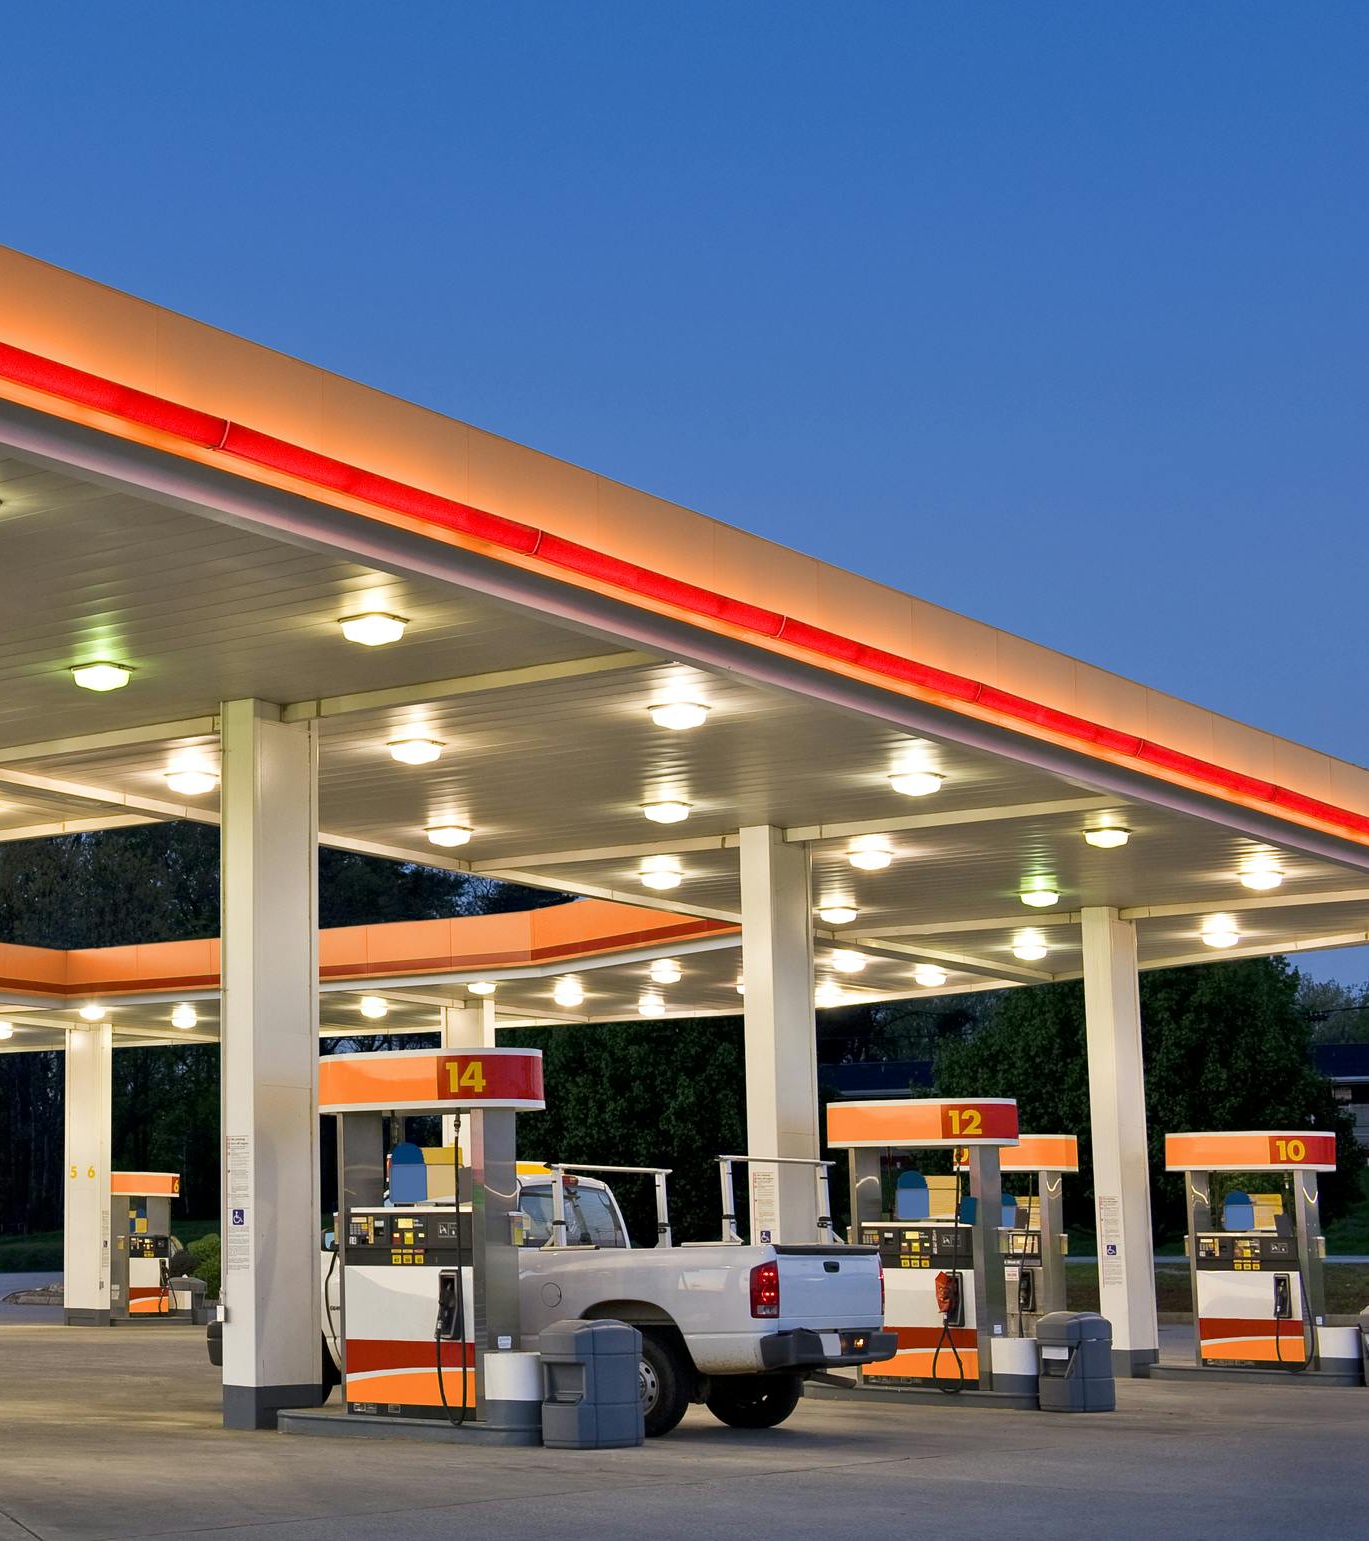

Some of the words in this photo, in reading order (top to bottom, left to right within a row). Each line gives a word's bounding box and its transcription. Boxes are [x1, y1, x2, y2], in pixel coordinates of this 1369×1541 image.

[445, 1061, 487, 1093] 14
[948, 1109, 983, 1135] 12
[1275, 1139, 1306, 1161] 10
[70, 1166, 78, 1179] 5
[87, 1165, 96, 1179] 6
[173, 1180, 180, 1193] 6
